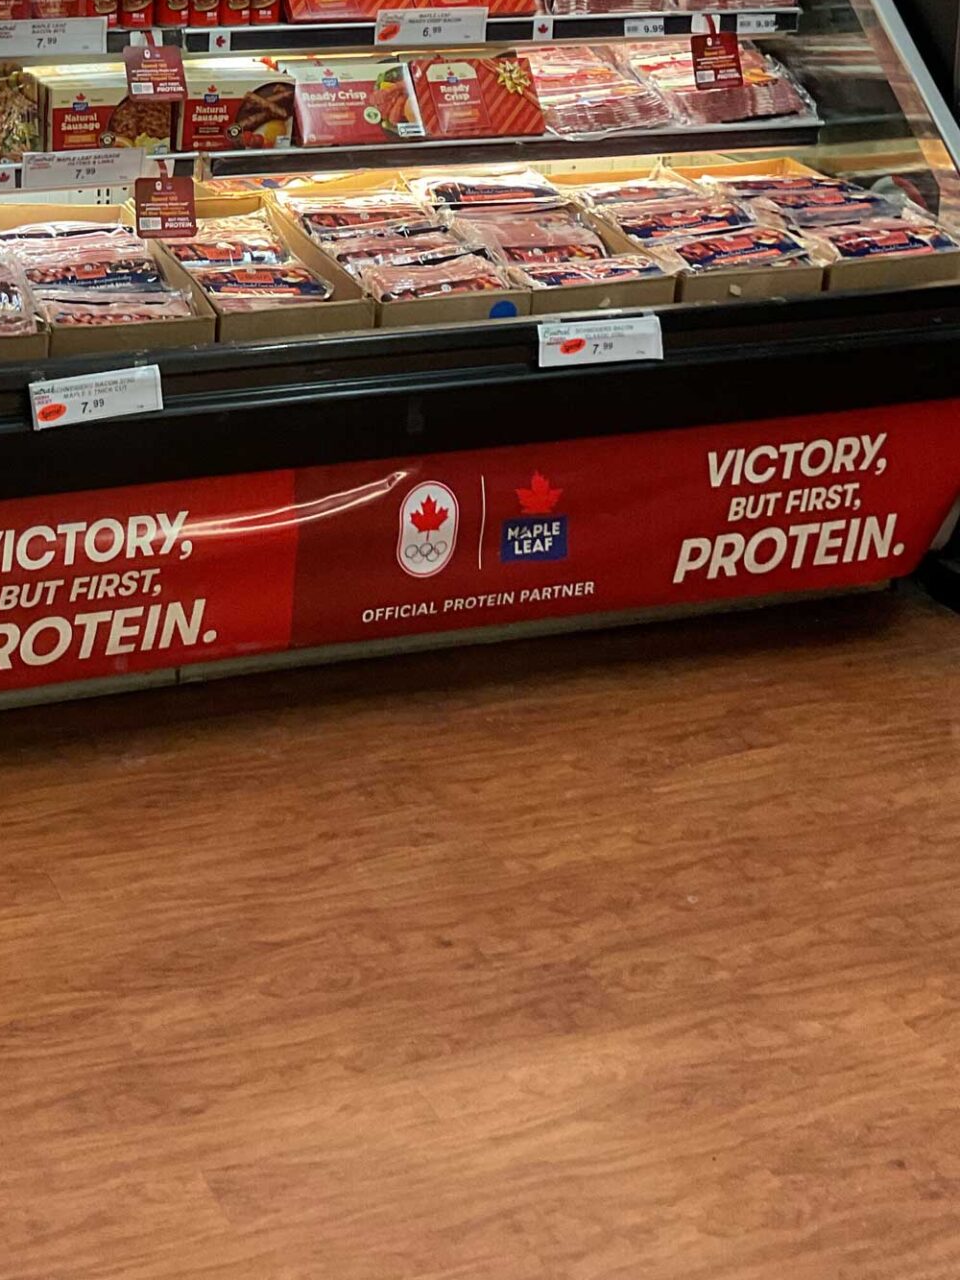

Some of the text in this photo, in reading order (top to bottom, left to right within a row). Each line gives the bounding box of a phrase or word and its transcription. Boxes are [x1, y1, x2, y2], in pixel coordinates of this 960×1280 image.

[643, 23, 664, 33] 9.99
[36, 37, 58, 49] 7.99
[440, 84, 470, 94] Ready
[302, 89, 367, 103] Ready Crisp
[444, 92, 470, 103] Crisp
[196, 105, 227, 115] Natural
[64, 113, 97, 123] Natural
[192, 113, 229, 122] Sausage
[61, 121, 101, 131] Sausage
[75, 168, 96, 180] 7.99
[592, 342, 613, 355] 7.99
[80, 398, 105, 414] 7.99
[707, 432, 887, 488] VICTORY,
[727, 482, 862, 522] BUT FIRST,
[507, 521, 560, 543] MAPLE
[513, 536, 553, 556] LEAF
[673, 512, 905, 583] PROTEIN.
[69, 568, 162, 603] FIRST,
[361, 580, 595, 623] OFFICIAL PROTEIN PARTNER
